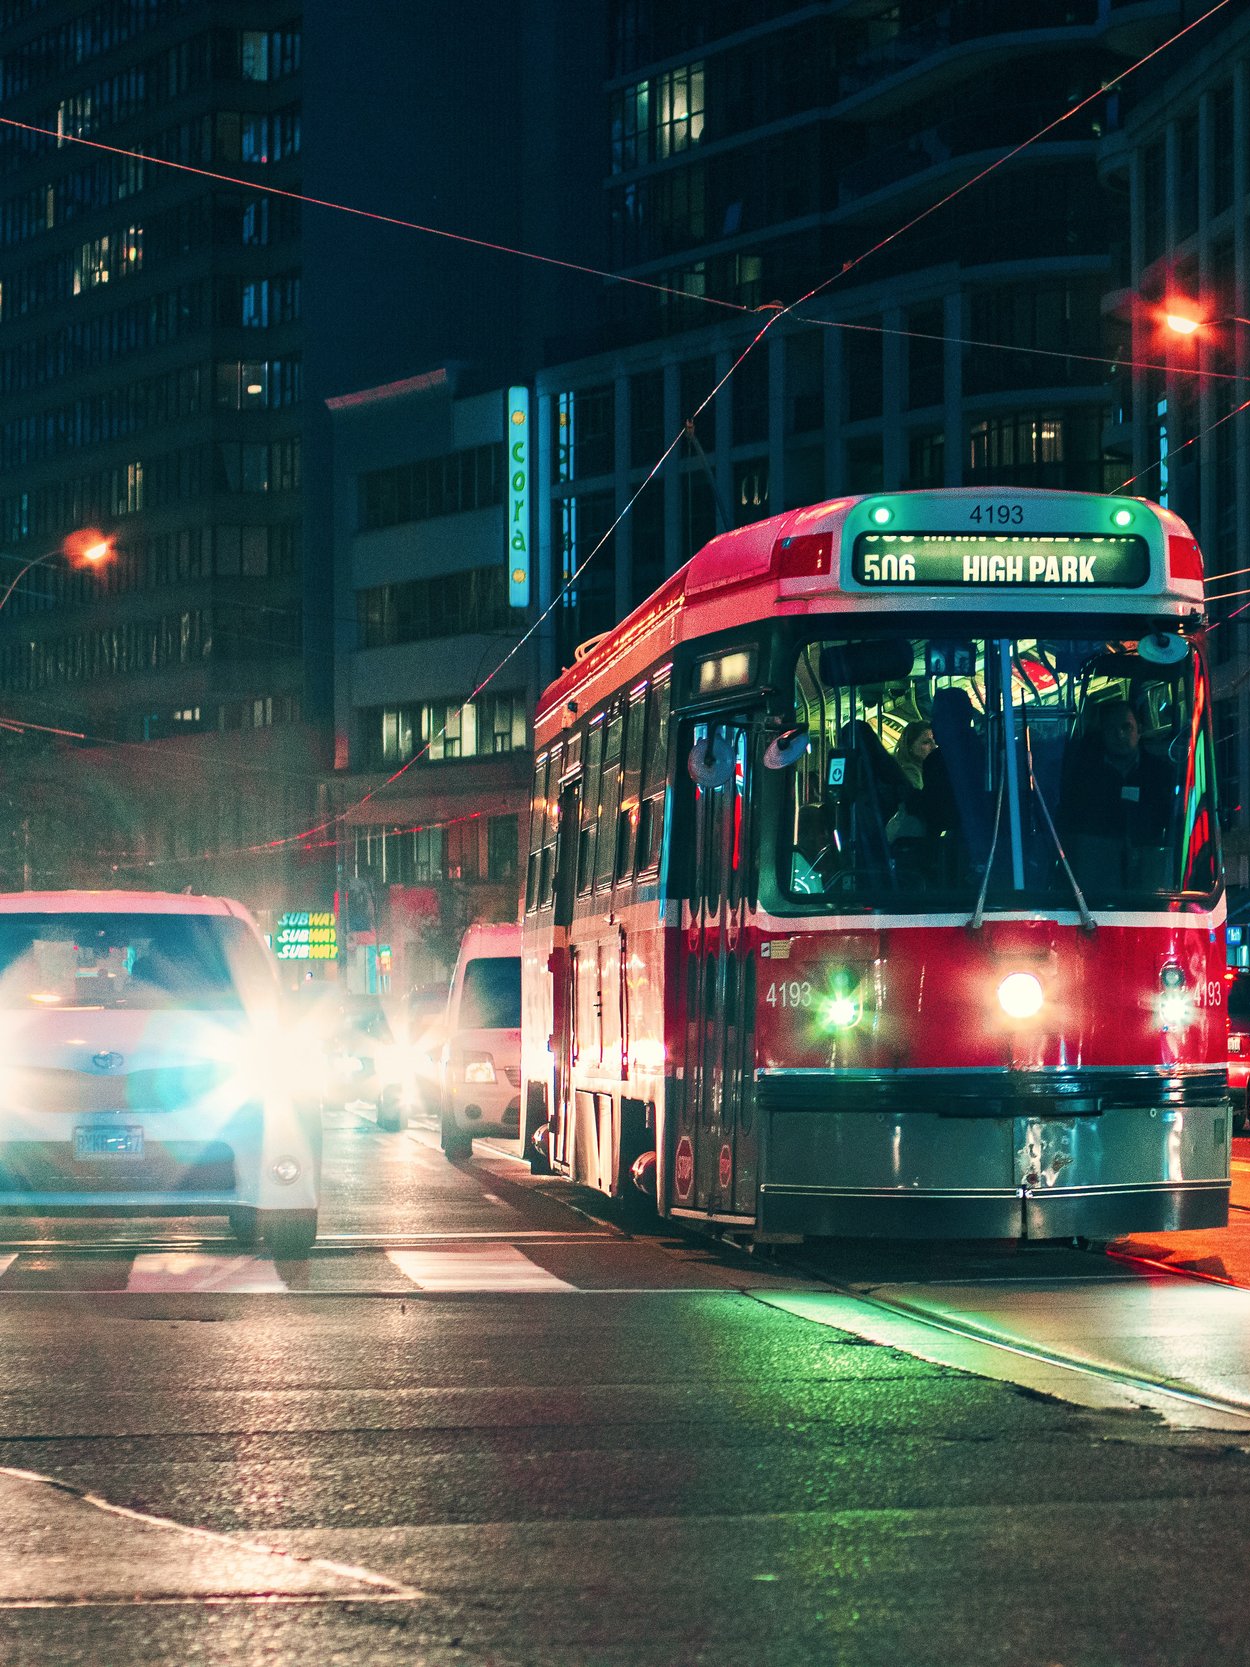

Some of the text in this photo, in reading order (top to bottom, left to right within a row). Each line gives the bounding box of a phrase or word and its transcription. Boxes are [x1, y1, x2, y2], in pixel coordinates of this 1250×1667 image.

[969, 505, 1024, 524] 4193
[864, 554, 1097, 583] 506 HIGH PARK
[277, 944, 338, 959] SUBWAY
[766, 982, 812, 1008] 4193
[1193, 981, 1221, 1006] 4193
